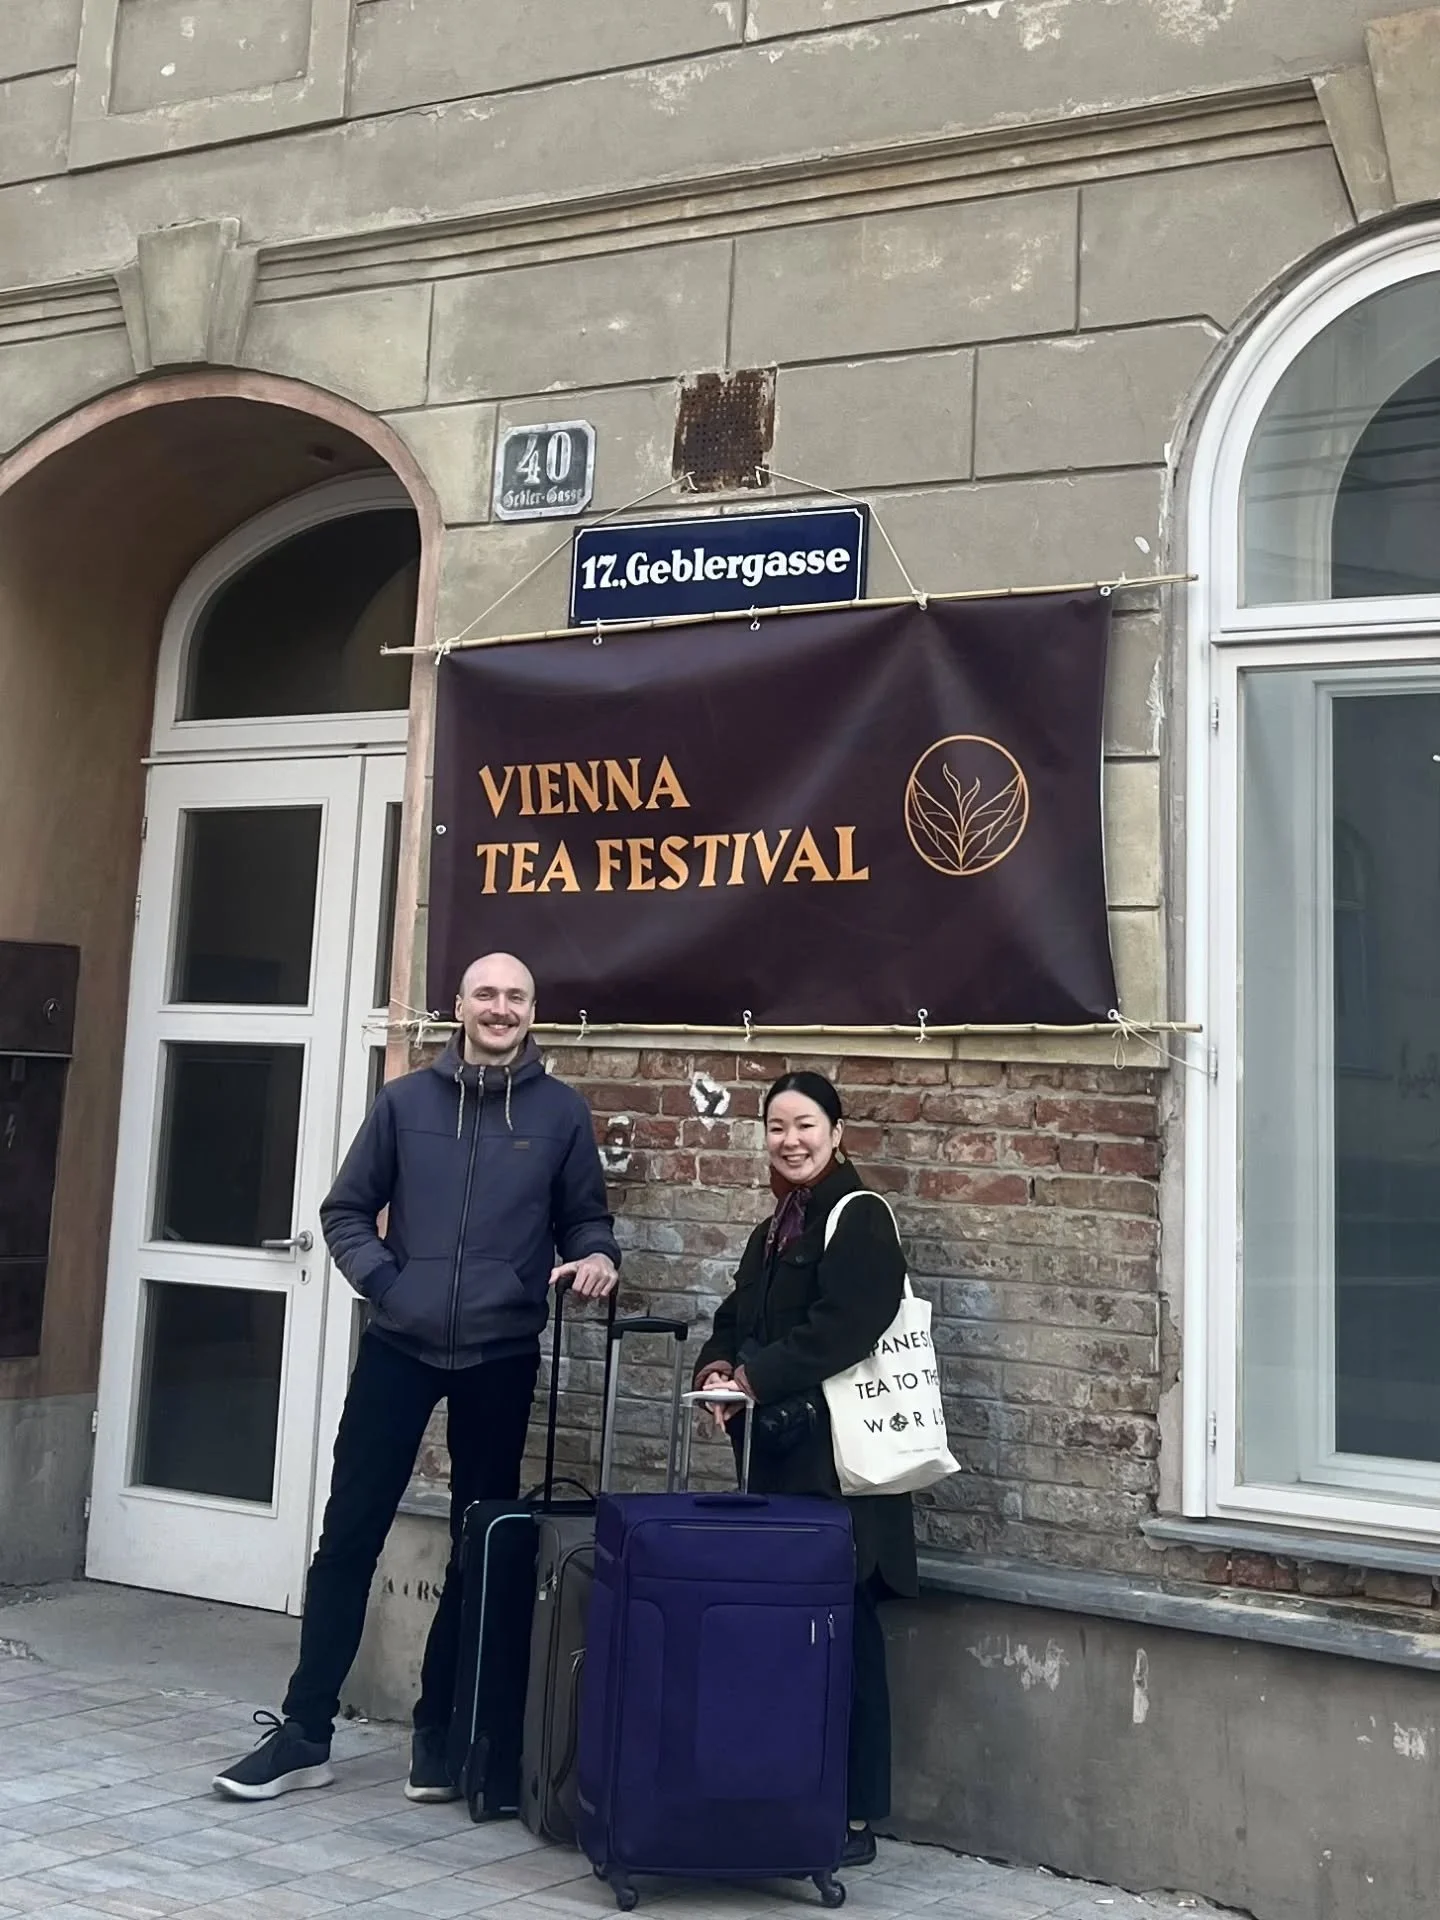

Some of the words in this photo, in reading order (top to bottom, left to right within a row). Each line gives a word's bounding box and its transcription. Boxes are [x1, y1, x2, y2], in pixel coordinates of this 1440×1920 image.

[516, 432, 572, 484] 40
[478, 754, 691, 819] VIENNA
[476, 839, 581, 895] TEA
[594, 825, 870, 892] FESTIVAL
[855, 1378, 890, 1400] TEA
[892, 1372, 918, 1391] TO
